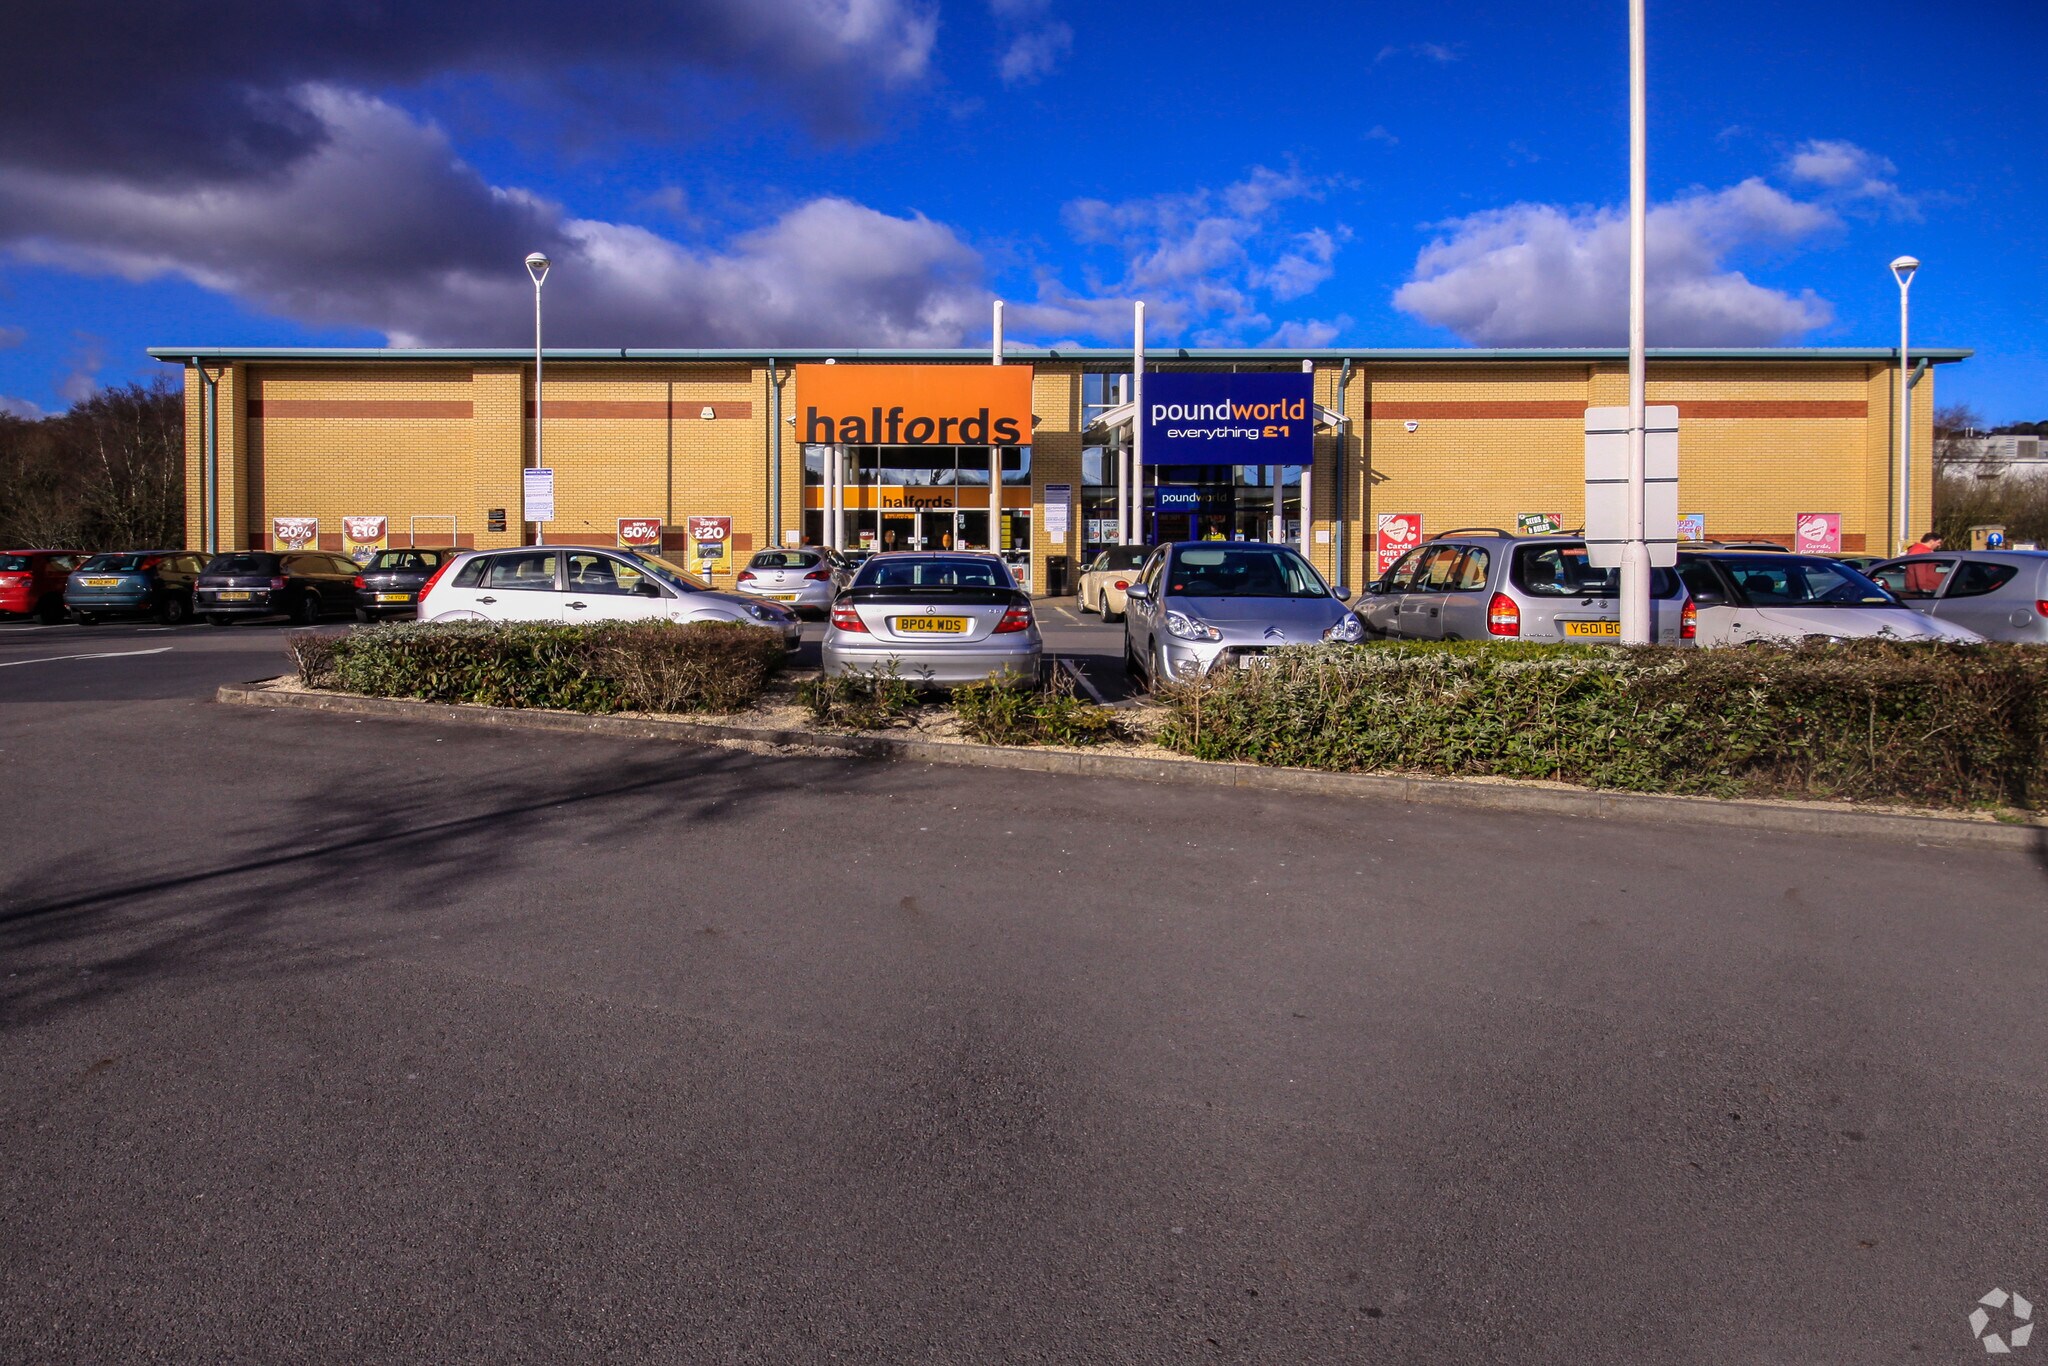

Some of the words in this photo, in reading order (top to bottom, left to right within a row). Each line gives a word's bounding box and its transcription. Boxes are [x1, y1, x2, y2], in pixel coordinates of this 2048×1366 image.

[1152, 398, 1305, 426] poundworld
[807, 407, 1021, 444] halfords
[1167, 426, 1260, 440] everything
[1262, 425, 1290, 438] £1
[883, 495, 953, 508] halfords
[1162, 492, 1228, 504] poundworld
[1677, 520, 1695, 528] ppy
[279, 526, 312, 538] 20%
[352, 525, 379, 537] £10
[623, 526, 656, 538] 50%
[695, 527, 724, 539] £20
[901, 619, 933, 630] BP04
[937, 619, 961, 630] WDS
[1571, 624, 1602, 634] Y601
